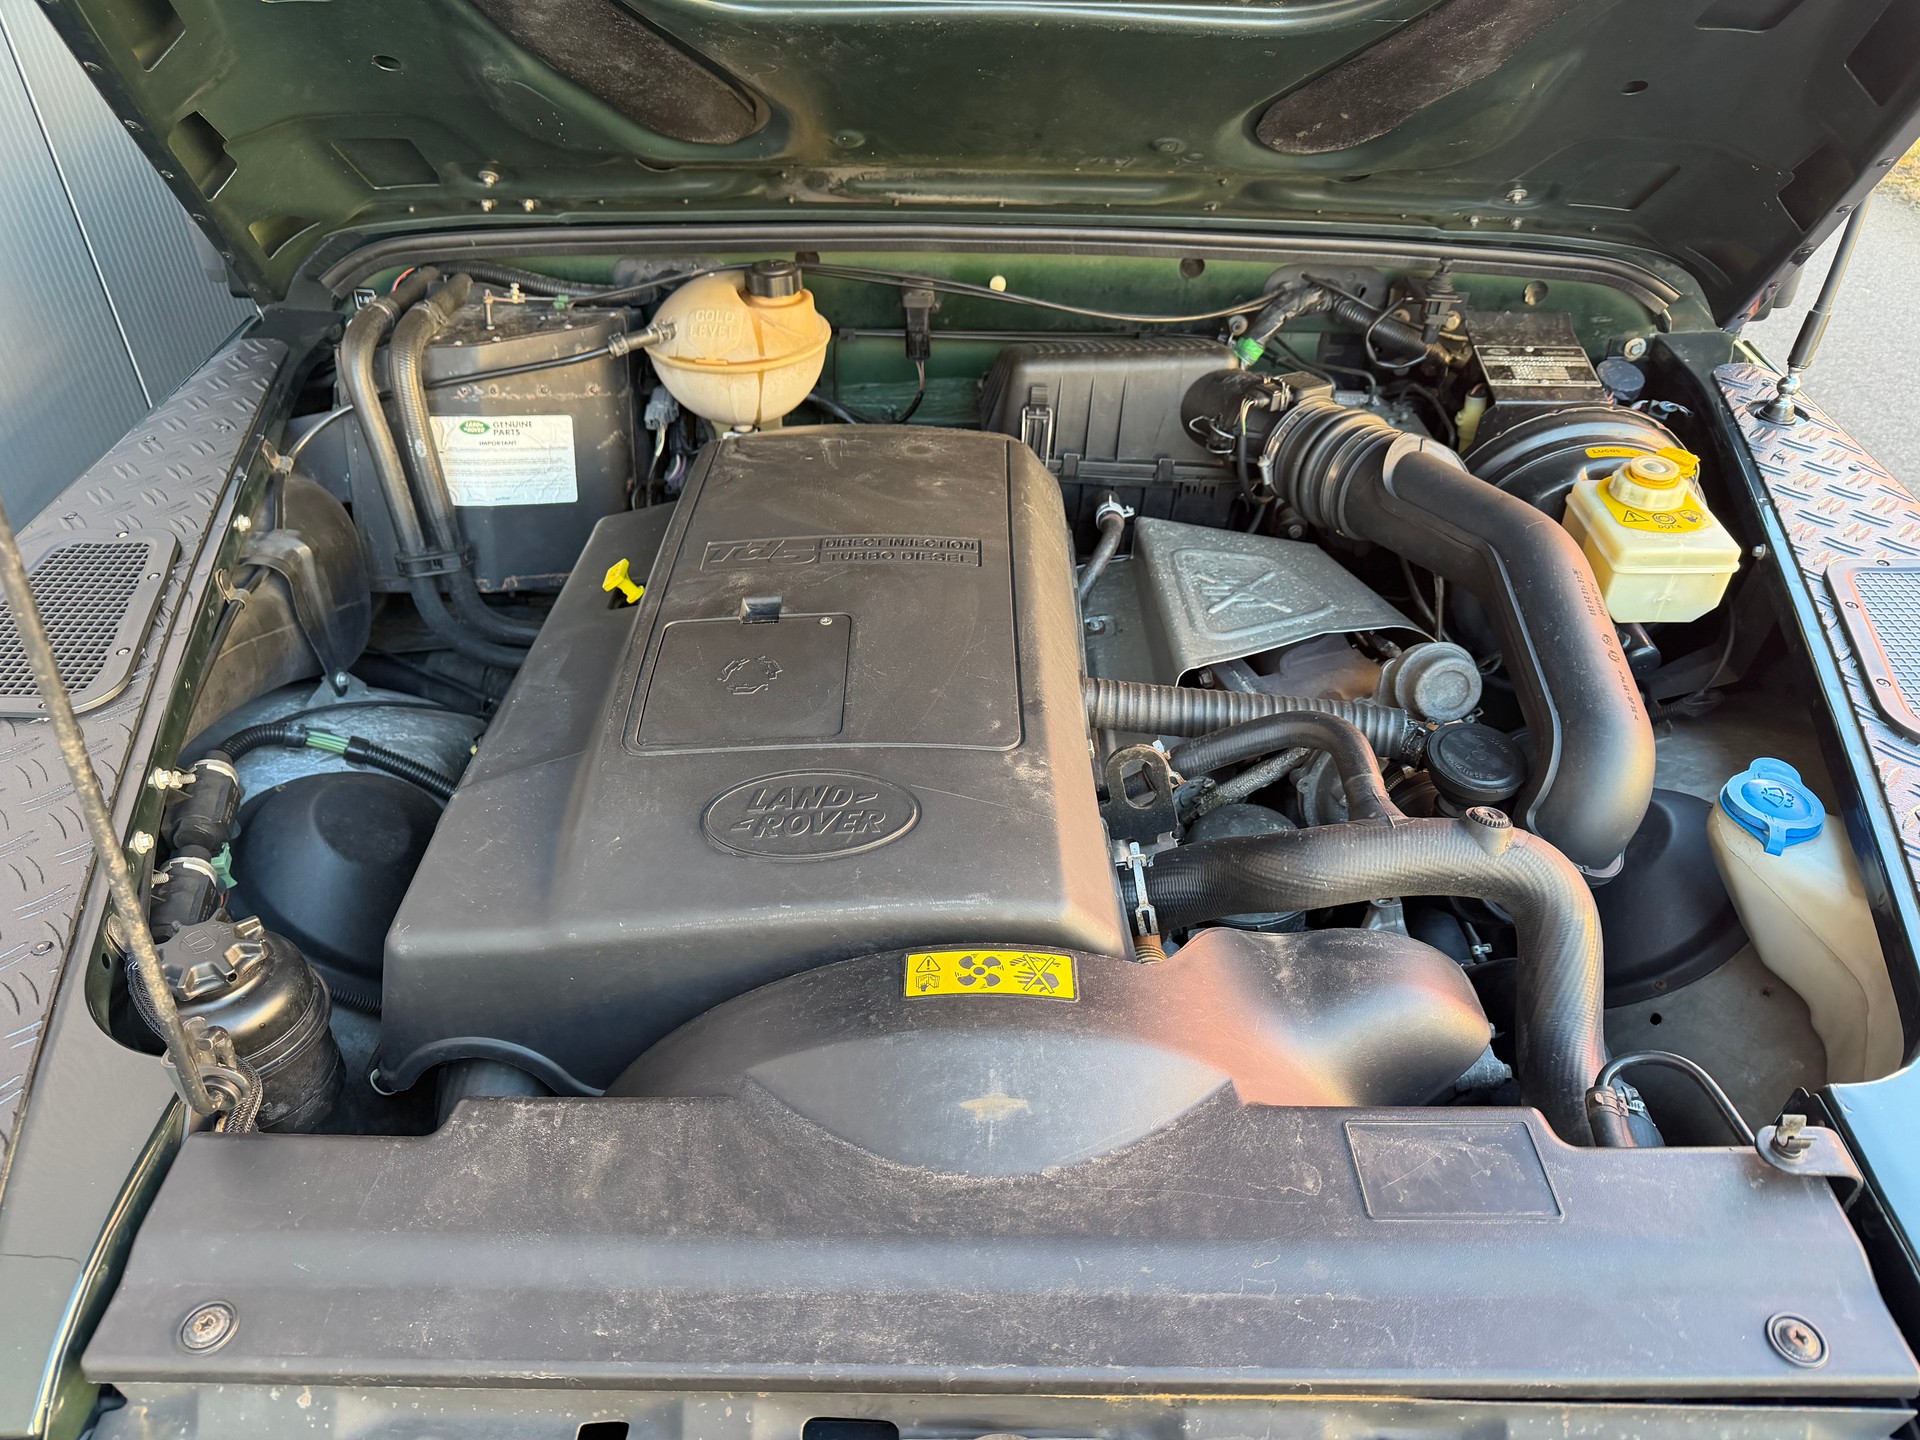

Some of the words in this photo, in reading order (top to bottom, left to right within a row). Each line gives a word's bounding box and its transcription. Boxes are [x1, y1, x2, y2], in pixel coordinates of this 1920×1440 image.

[689, 323, 733, 338] LEVEL
[825, 537, 885, 548] DIRECT
[888, 537, 976, 550] INJECTION
[827, 550, 896, 561] TURBO
[900, 550, 971, 563] DIESEL
[747, 785, 854, 811] LAND
[753, 810, 887, 838] ROVER
